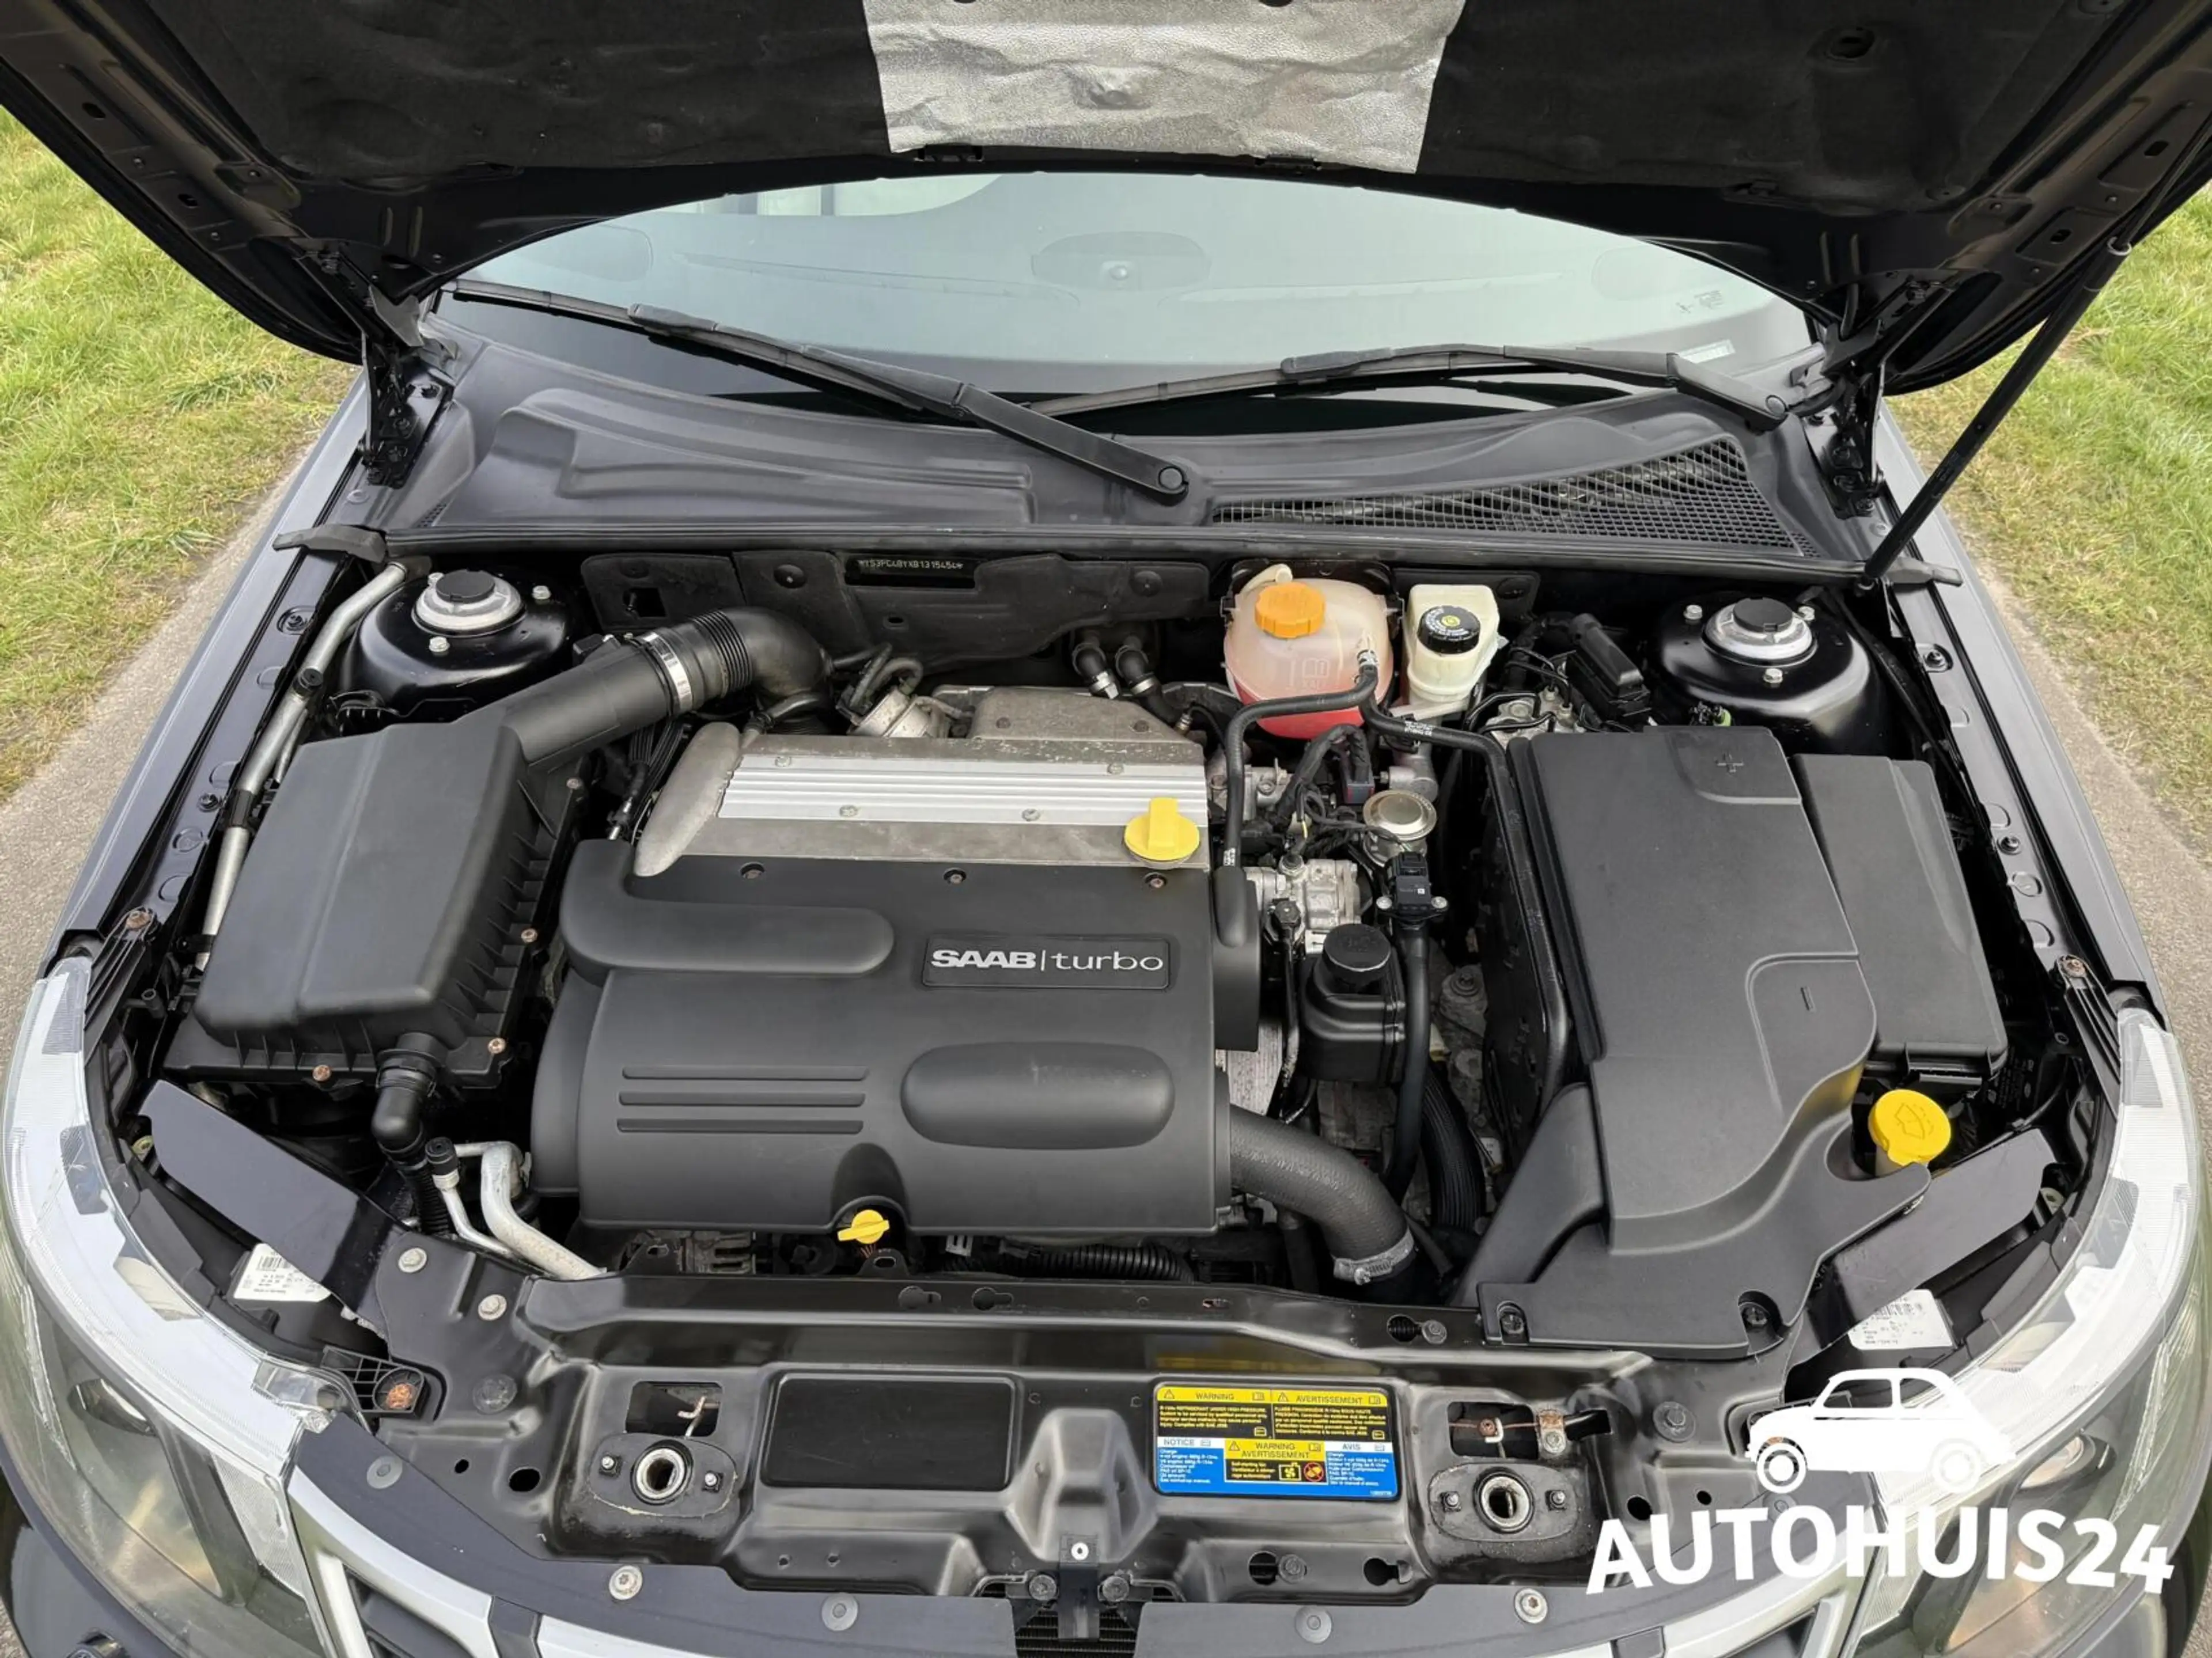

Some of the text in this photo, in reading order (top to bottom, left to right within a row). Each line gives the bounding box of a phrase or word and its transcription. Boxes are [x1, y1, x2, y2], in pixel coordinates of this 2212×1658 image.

[931, 949, 1164, 971] SAAB turbo
[1195, 1393, 1234, 1401] WARNING
[1296, 1395, 1362, 1405] AVERTISSEMENT
[1255, 1442, 1296, 1451] WARNING
[1241, 1450, 1310, 1459] AVERTISSEMENT
